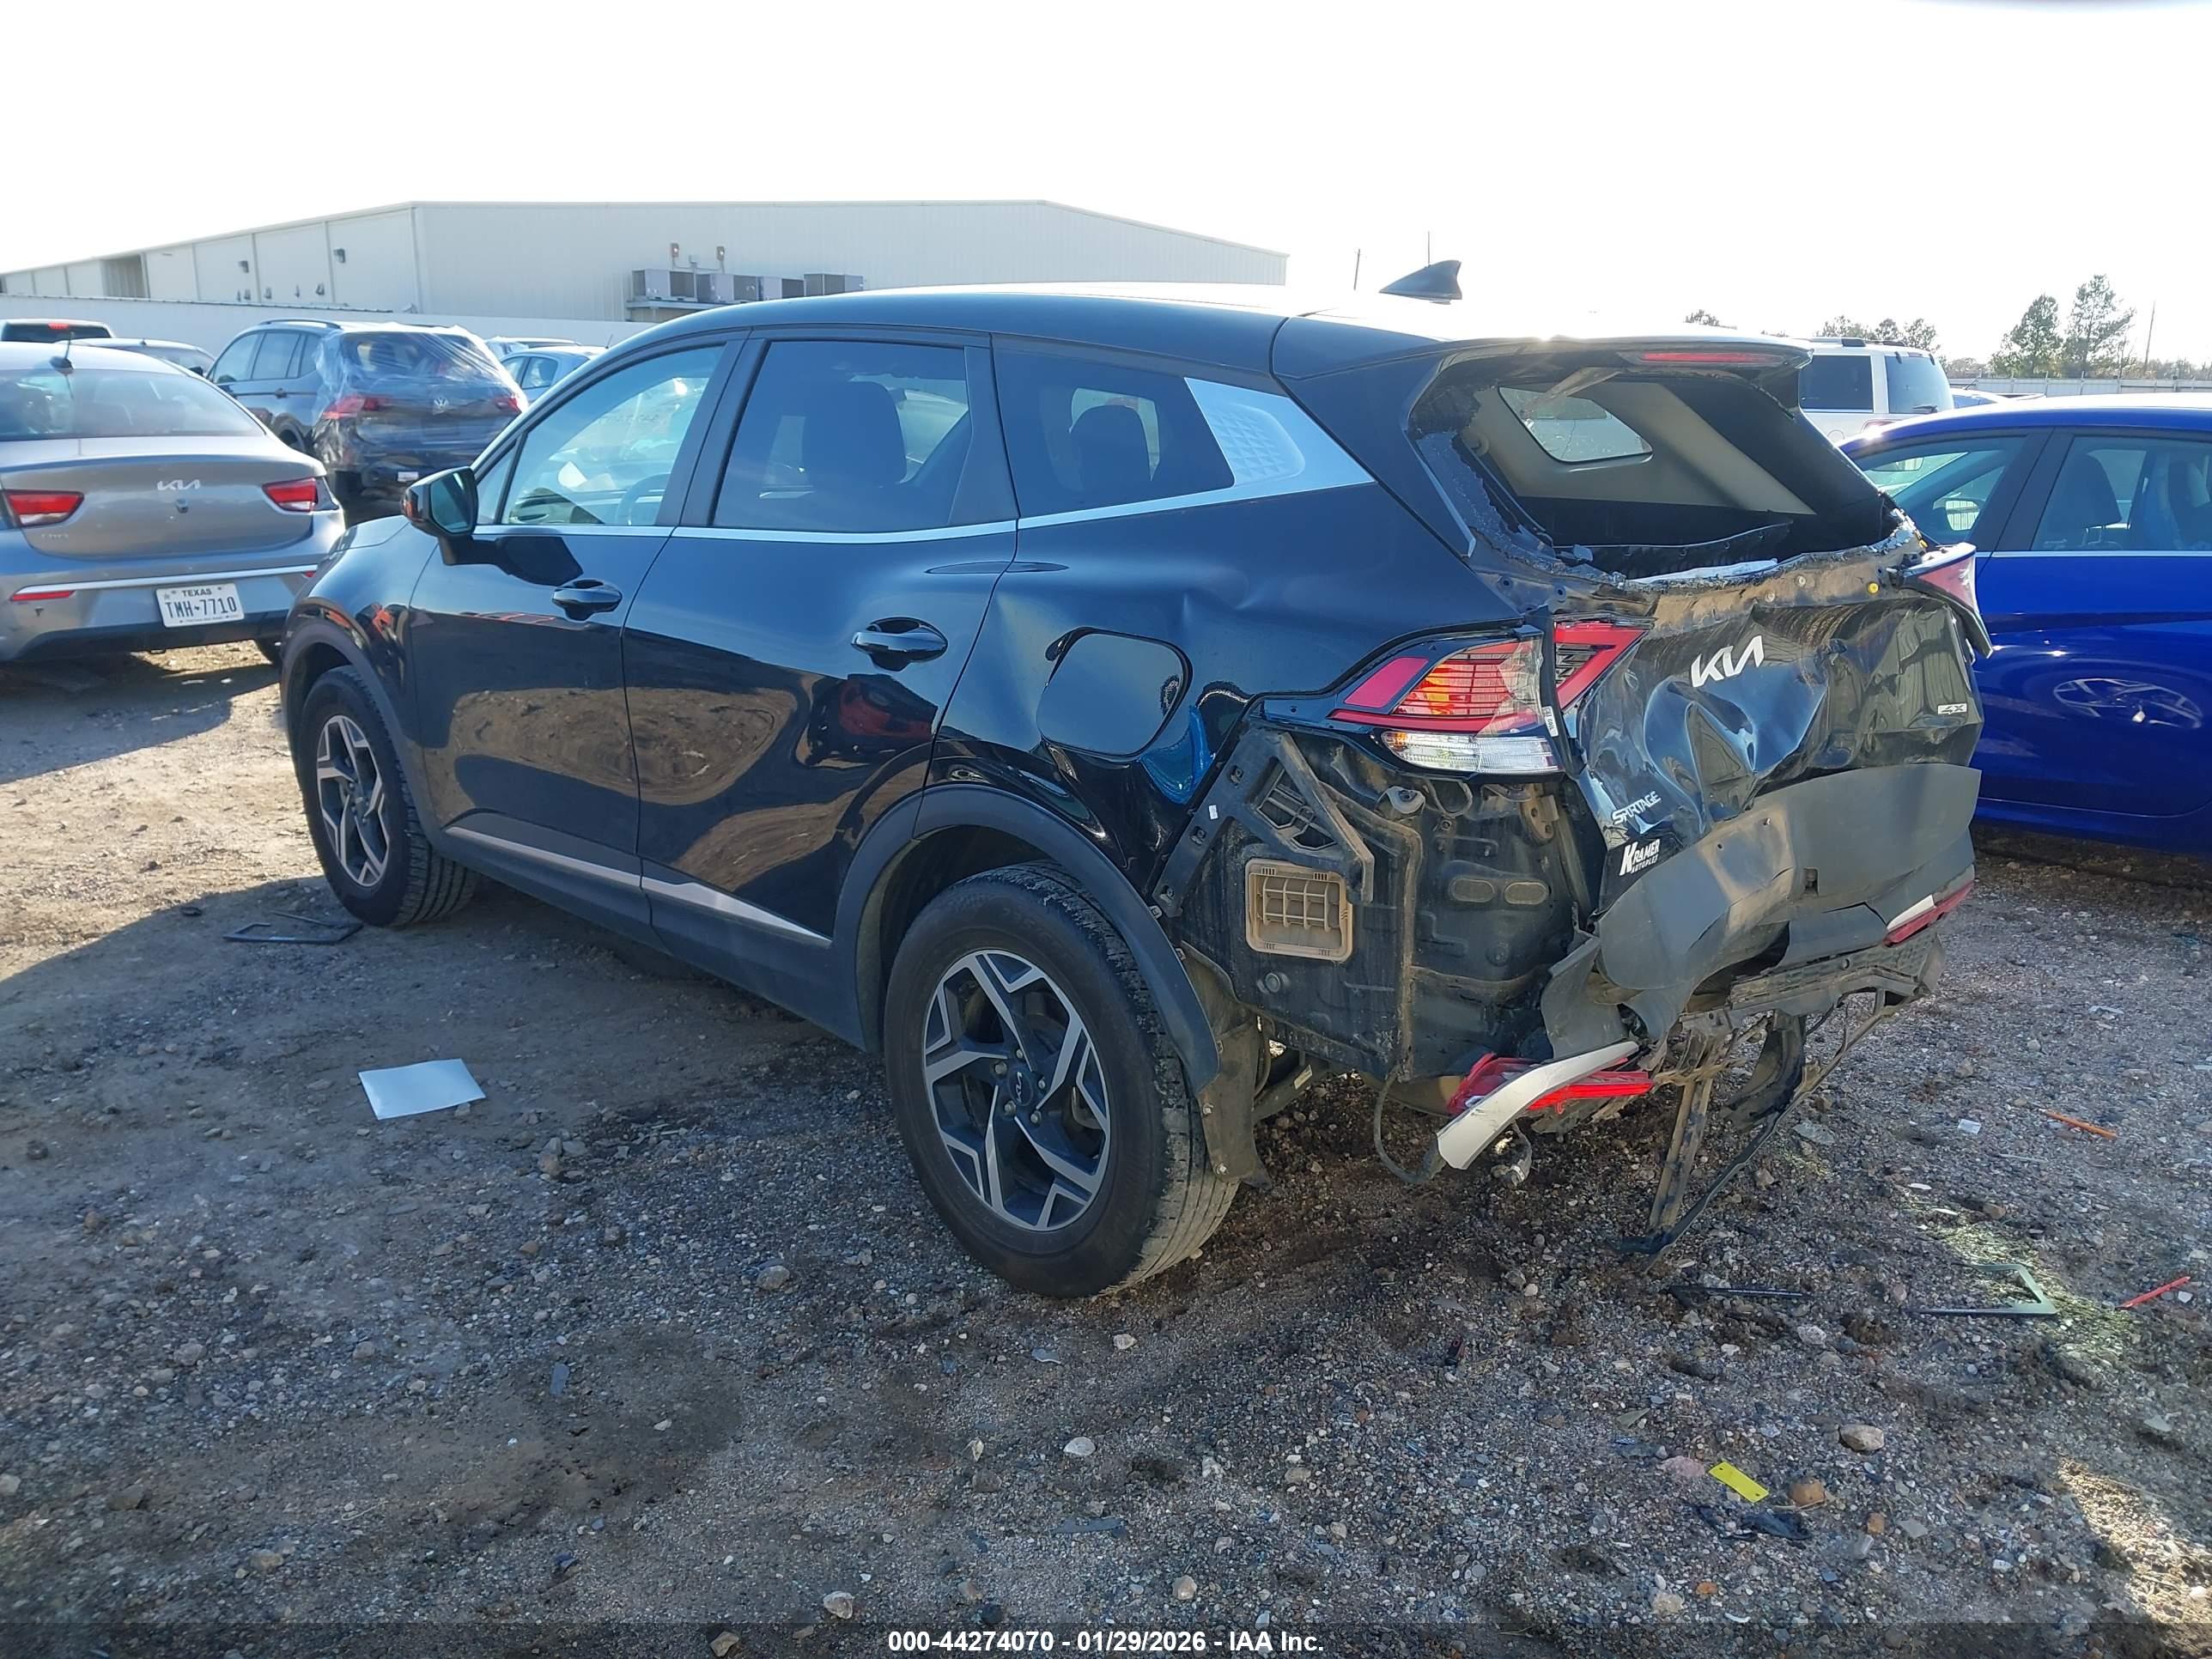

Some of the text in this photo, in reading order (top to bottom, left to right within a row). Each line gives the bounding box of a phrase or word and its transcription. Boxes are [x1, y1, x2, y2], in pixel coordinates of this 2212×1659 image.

[157, 479, 200, 490] KIA
[181, 588, 212, 598] TEXAS
[1692, 635, 1764, 688] KIA
[1612, 790, 1662, 825] SPORTAGE
[1619, 838, 1661, 876] KRAMER
